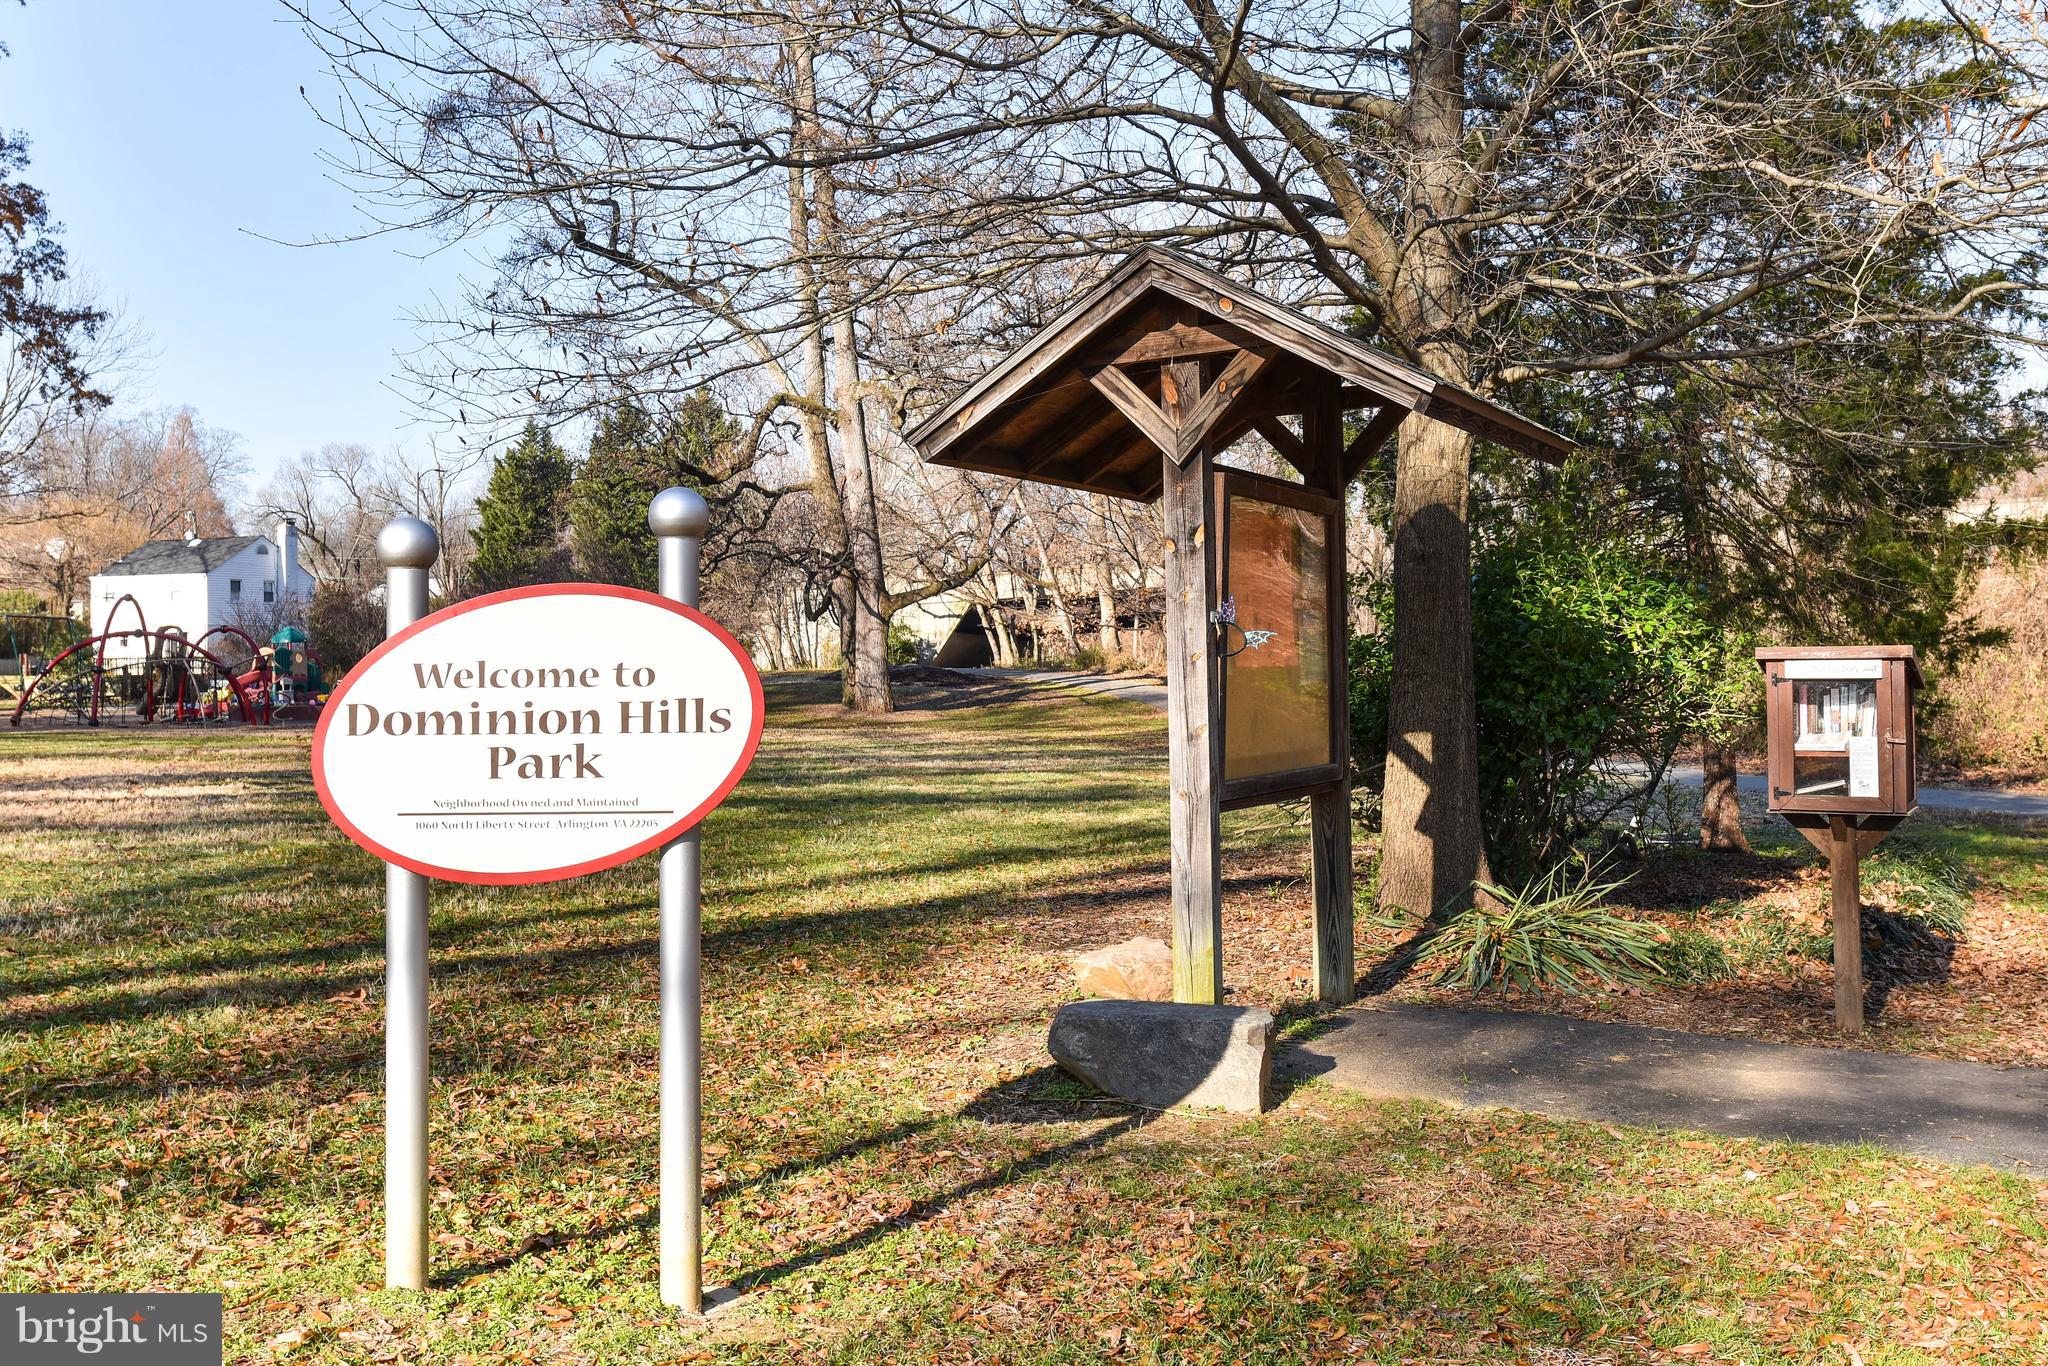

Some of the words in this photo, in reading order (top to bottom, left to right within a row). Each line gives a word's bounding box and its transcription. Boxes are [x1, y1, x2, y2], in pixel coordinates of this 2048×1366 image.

[413, 661, 600, 689] Welcome
[612, 663, 656, 688] to
[346, 701, 602, 736] Dominion
[618, 697, 732, 734] Hills
[488, 743, 605, 779] Park
[433, 798, 510, 810] Neighborhood
[512, 798, 550, 808] Owned
[552, 797, 574, 807] and
[576, 797, 639, 807] Maintained
[415, 821, 439, 830] 1060
[441, 820, 473, 830] North
[475, 820, 515, 832] Liberty
[613, 819, 627, 829] VA
[629, 819, 659, 829] 22205
